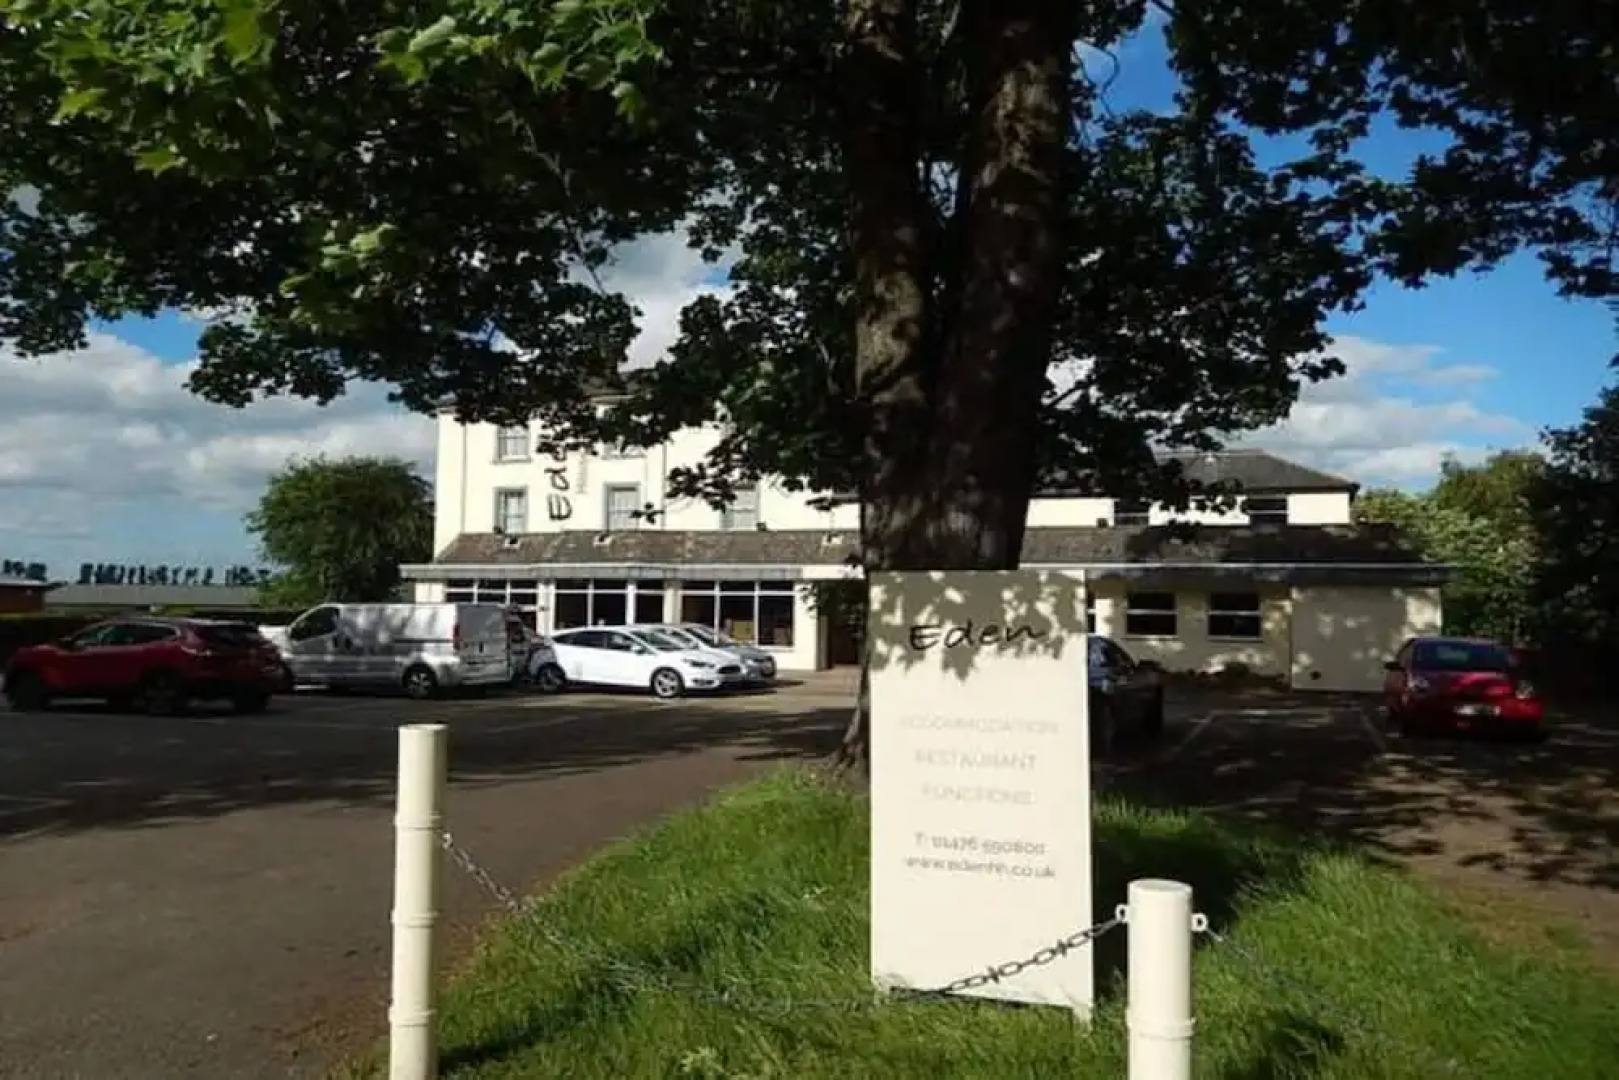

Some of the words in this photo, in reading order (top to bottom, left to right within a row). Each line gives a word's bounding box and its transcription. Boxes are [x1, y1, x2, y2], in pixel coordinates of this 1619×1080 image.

[910, 618, 1046, 650] Eden
[914, 748, 1037, 770] RESTAURANT
[921, 782, 1034, 805] FUNCTIONS
